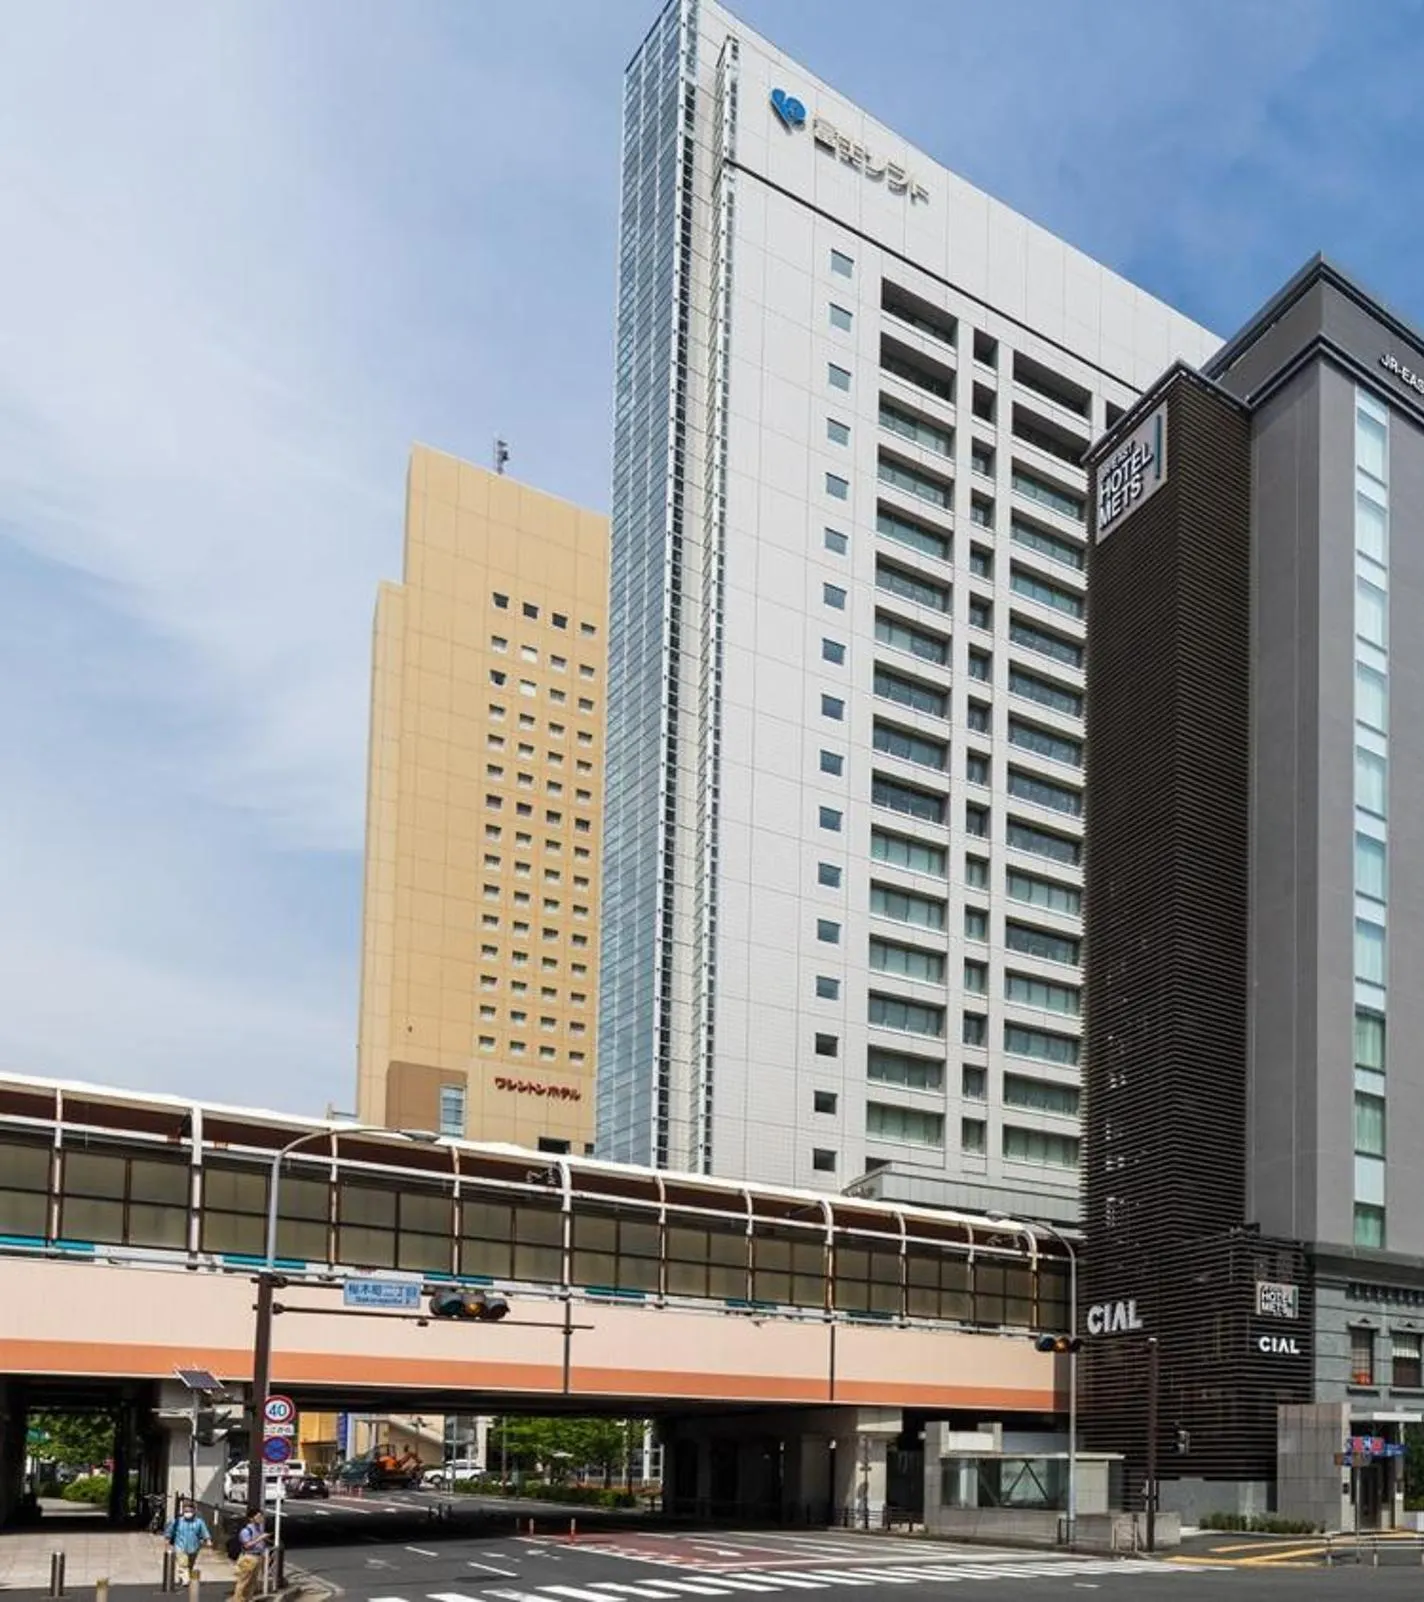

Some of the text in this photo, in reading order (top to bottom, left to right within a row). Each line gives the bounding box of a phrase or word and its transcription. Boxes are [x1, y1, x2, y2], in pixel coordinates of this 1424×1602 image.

[1100, 443, 1154, 499] HOTEL
[1100, 474, 1143, 527] METS
[1087, 1299, 1143, 1334] CIAL
[1259, 1336, 1300, 1354] CIAL
[269, 1404, 288, 1417] 40
